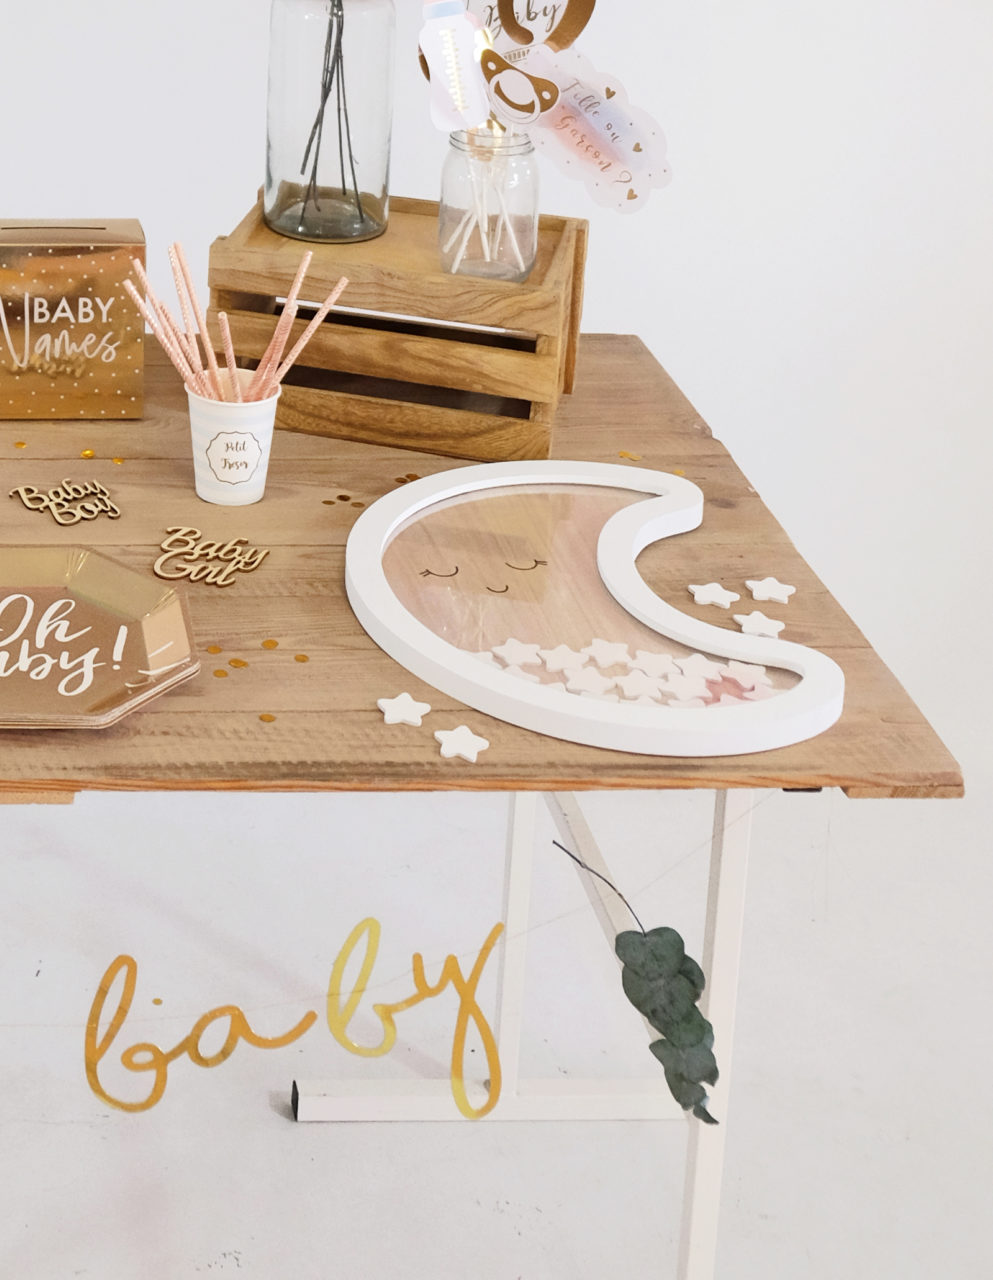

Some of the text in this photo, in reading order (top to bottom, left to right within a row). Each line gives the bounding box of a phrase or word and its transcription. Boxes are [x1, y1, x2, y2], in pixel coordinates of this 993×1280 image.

[33, 297, 115, 324] BABY
[9, 478, 113, 513] Baby
[48, 494, 121, 526] Boy
[160, 525, 271, 573] Baby
[85, 917, 504, 1120] baby
